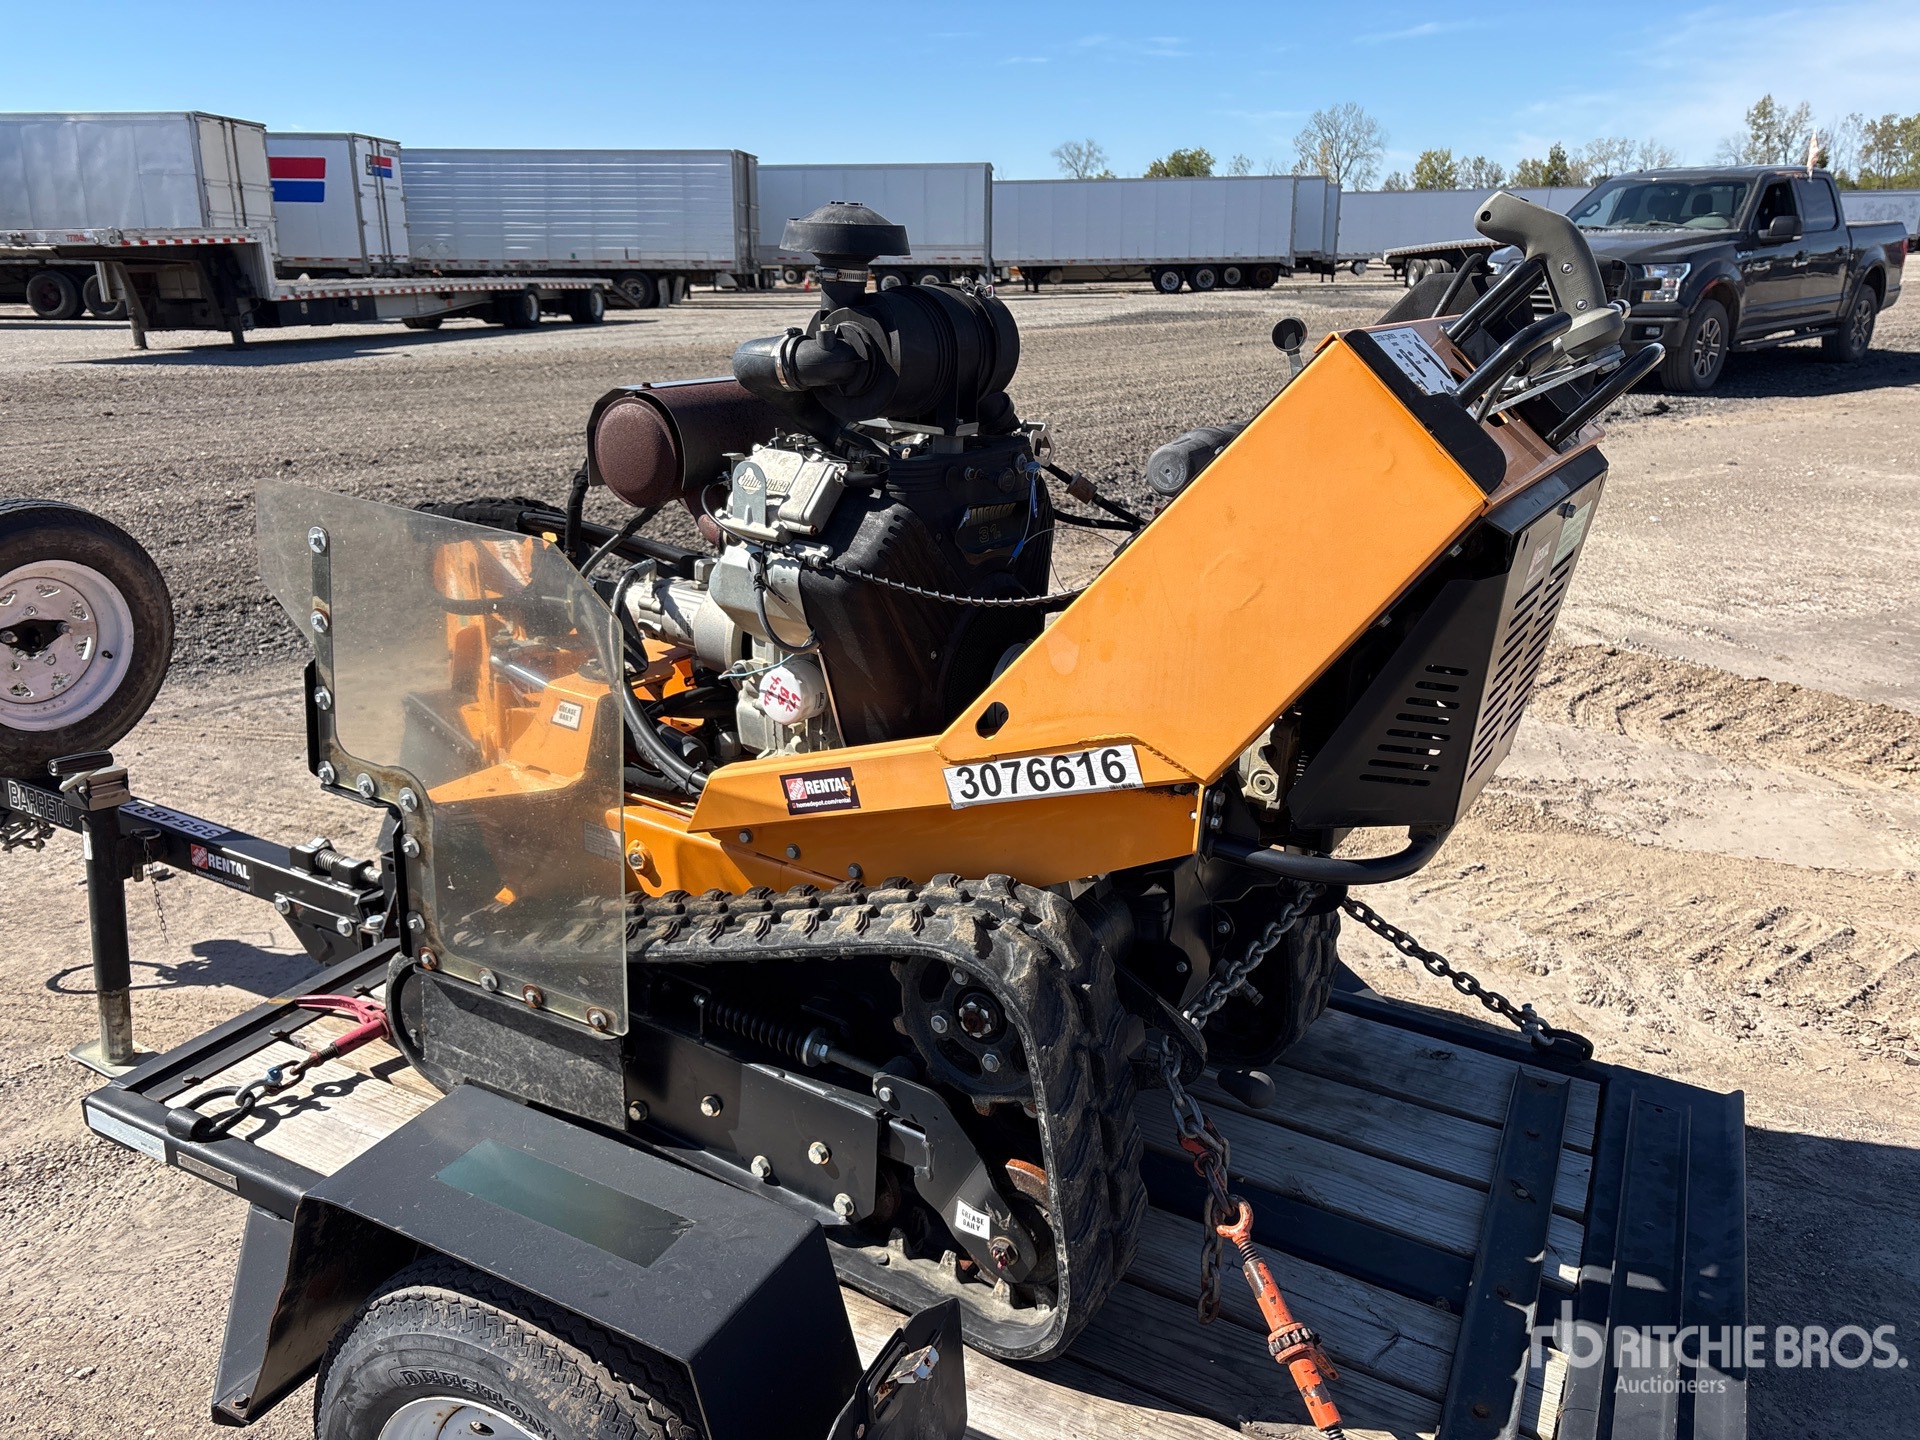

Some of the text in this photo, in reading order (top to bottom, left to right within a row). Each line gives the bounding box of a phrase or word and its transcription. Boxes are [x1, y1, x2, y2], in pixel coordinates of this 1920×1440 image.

[956, 749, 1127, 800] 3076616
[8, 780, 74, 828] BARRETO
[120, 803, 223, 837] 3554837
[208, 853, 251, 880] RENTAL
[961, 1208, 984, 1226] GREASE
[963, 1218, 981, 1232] DAILY
[400, 1368, 560, 1440] DEESTON
